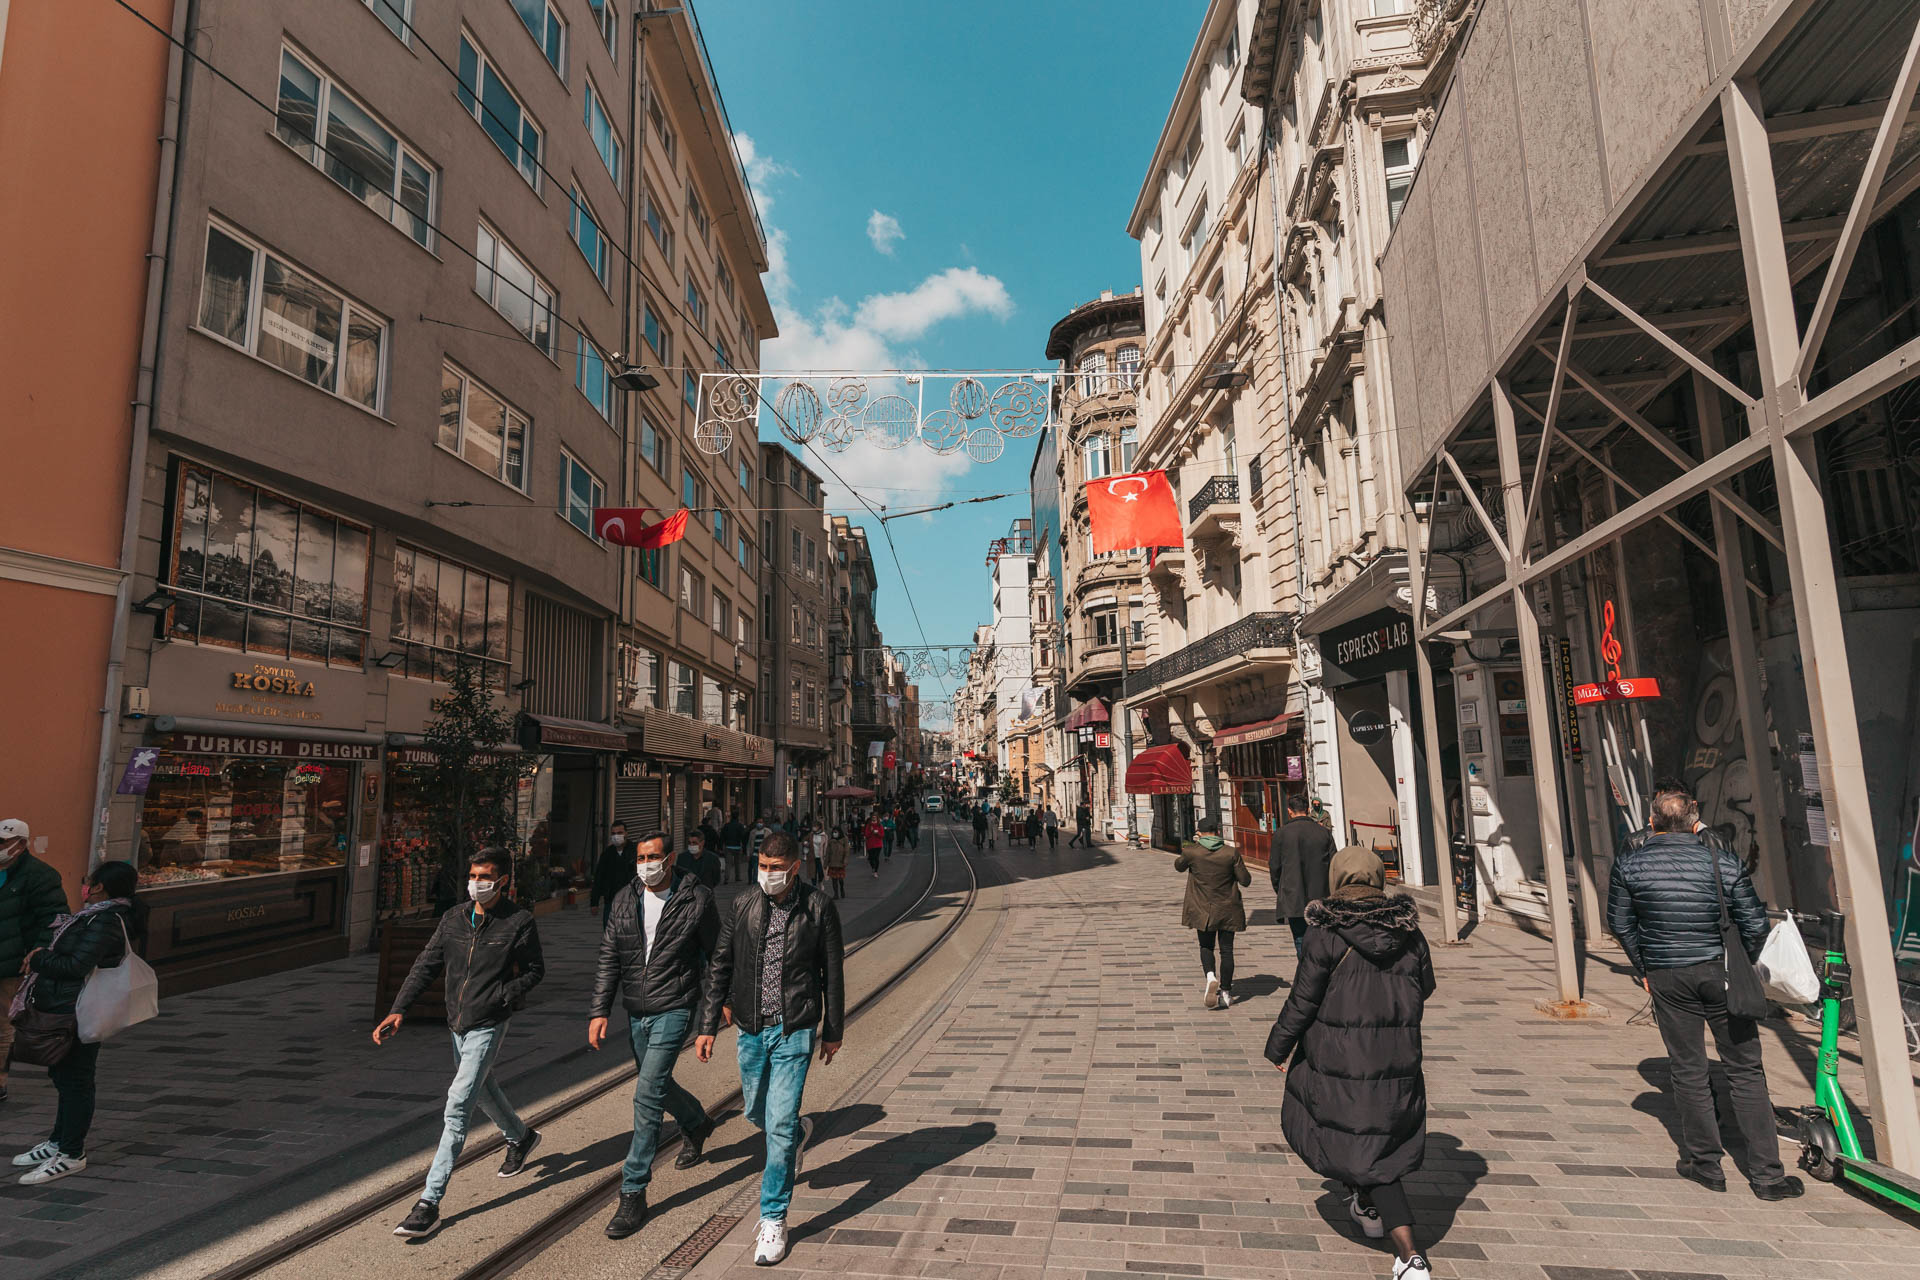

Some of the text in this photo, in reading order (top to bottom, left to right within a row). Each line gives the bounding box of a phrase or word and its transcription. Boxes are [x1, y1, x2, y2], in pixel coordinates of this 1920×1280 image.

[233, 671, 316, 697] KOSKA
[1577, 683, 1632, 699] Müzik 5
[1562, 647, 1580, 745] TOBACCO SHOP
[184, 735, 373, 759] TURKISH DELIGHT
[295, 773, 321, 784] Delight
[1160, 785, 1191, 793] LEBON
[228, 904, 265, 921] KOSKA
